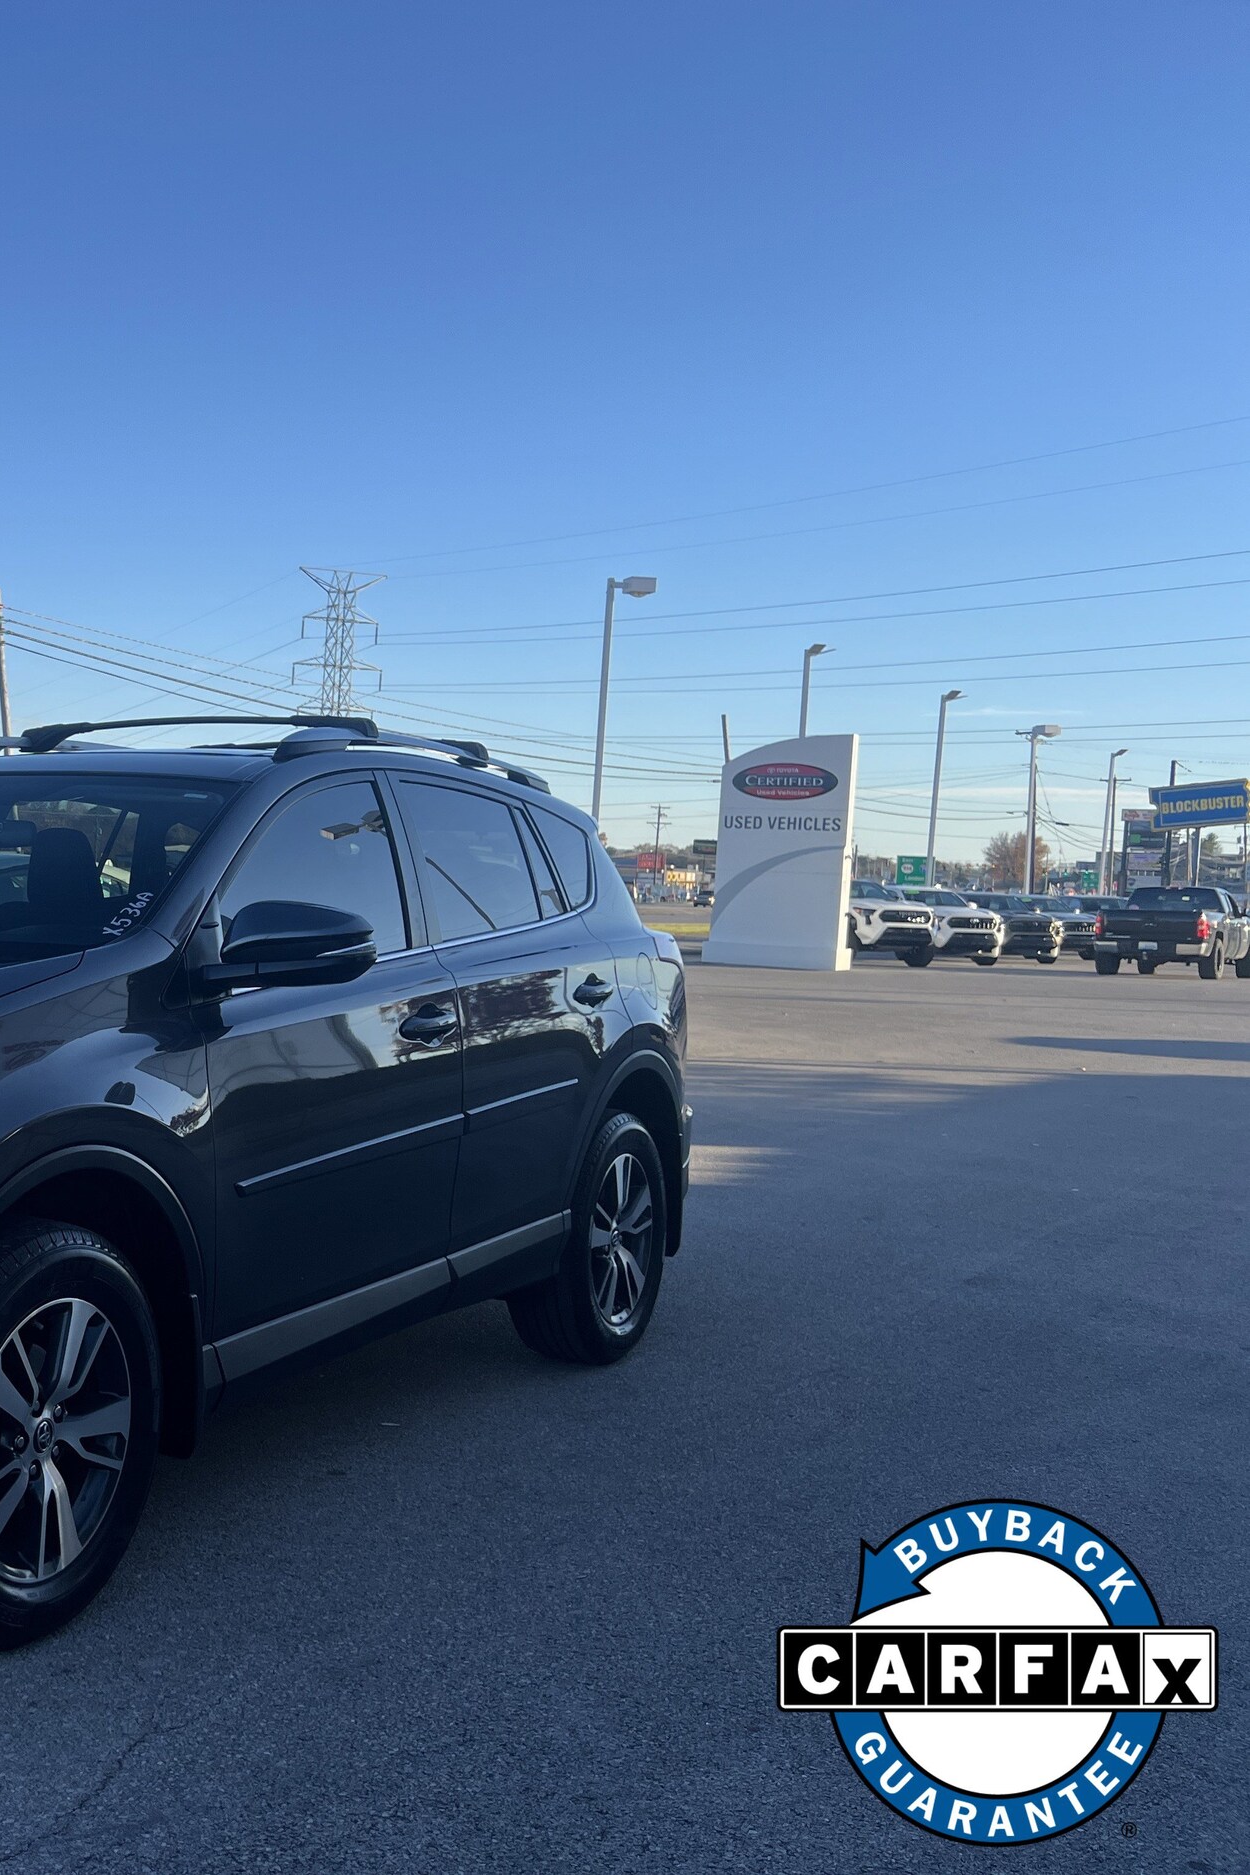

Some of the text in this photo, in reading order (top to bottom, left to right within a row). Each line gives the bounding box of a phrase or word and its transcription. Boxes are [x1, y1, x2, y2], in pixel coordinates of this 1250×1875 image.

[745, 774, 824, 787] CERTIFIED
[777, 789, 810, 797] Vehicles
[1162, 795, 1245, 815] BLOCKBUSTER
[724, 815, 842, 832] USED VEHICLES
